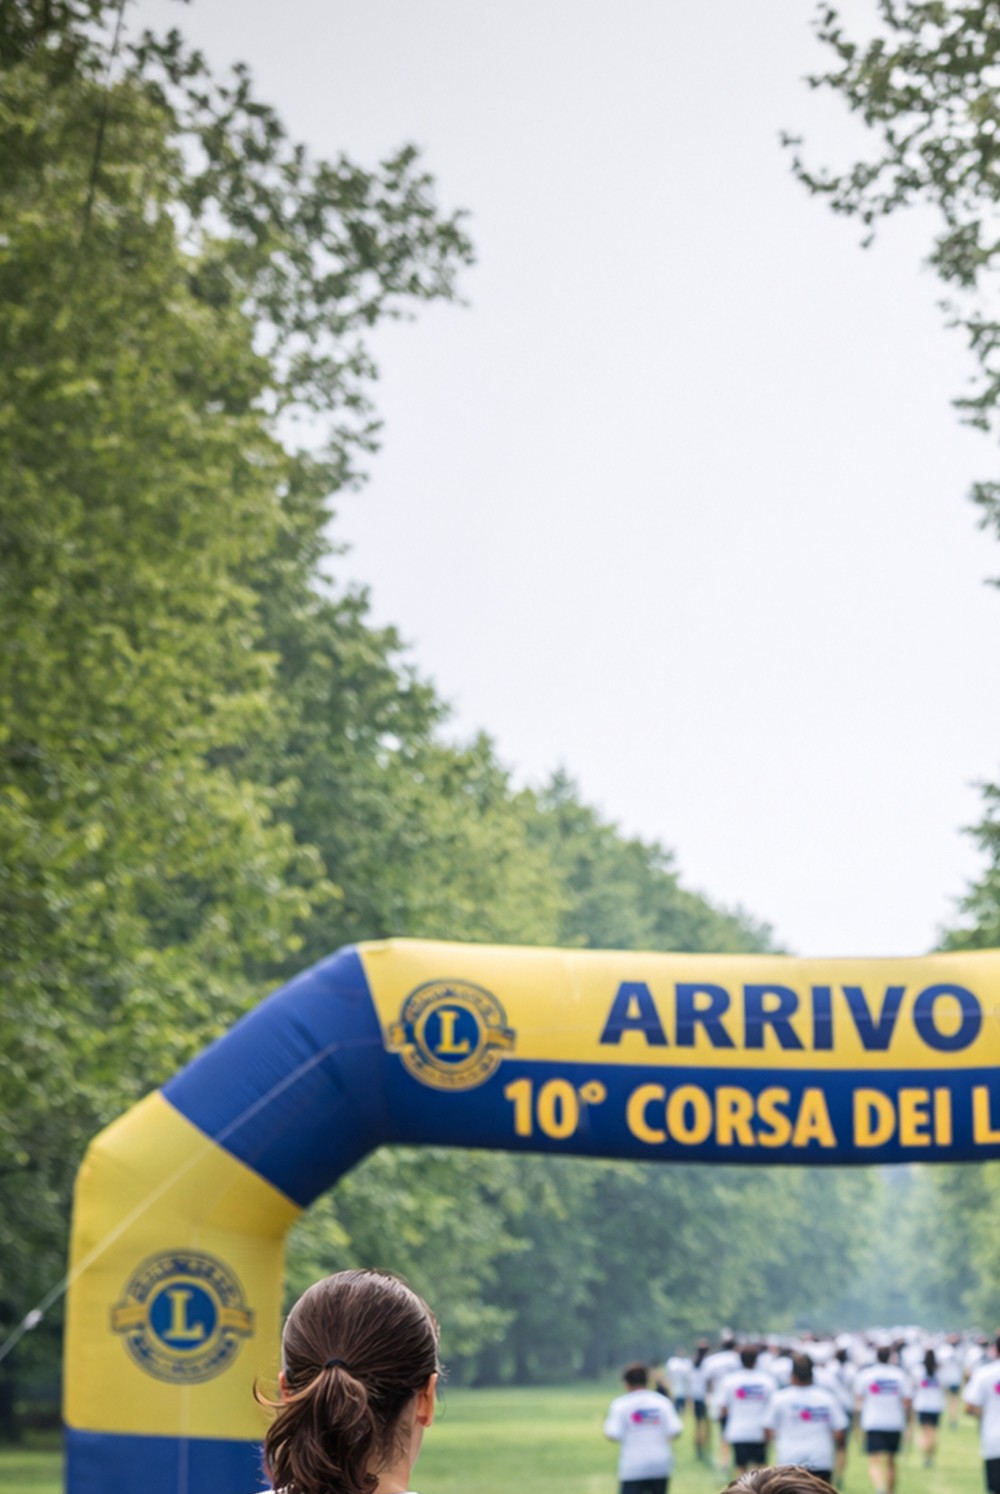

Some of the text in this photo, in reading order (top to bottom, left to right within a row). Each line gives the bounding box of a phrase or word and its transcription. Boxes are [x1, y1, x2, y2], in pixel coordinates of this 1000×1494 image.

[436, 1010, 471, 1055] L
[598, 981, 984, 1054] ARRIVO
[506, 1079, 605, 1138] 10°
[627, 1084, 836, 1148] CORSA
[854, 1088, 951, 1147] DEI
[163, 1289, 205, 1341] L
